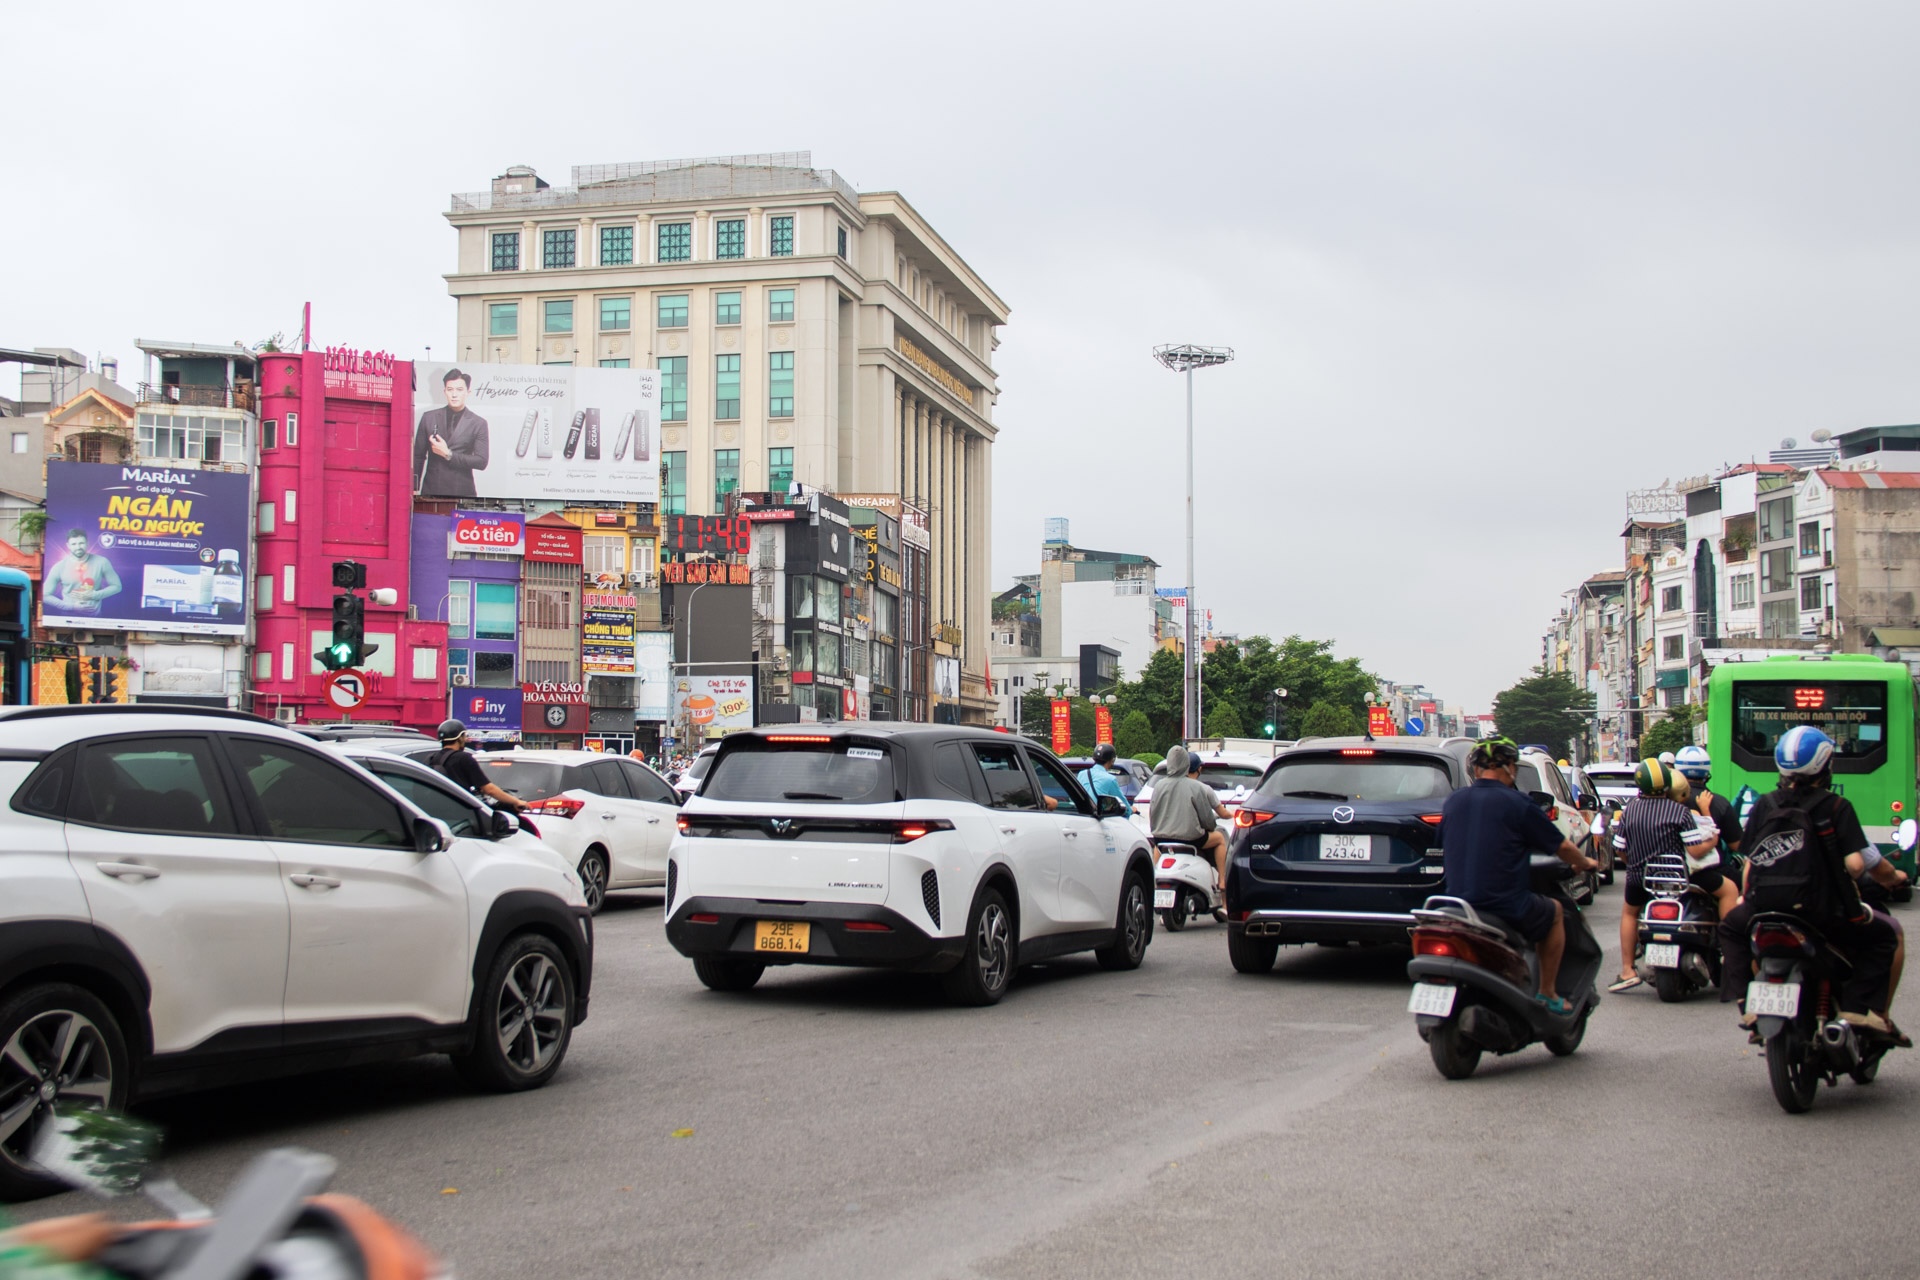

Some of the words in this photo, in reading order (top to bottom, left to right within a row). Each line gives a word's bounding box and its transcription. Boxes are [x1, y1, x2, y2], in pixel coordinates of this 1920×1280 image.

[325, 342, 358, 374] NÓN
[363, 350, 395, 378] SƠN
[107, 494, 192, 519] NGĂN
[99, 515, 142, 531] TRÀO
[145, 520, 204, 538] NGƯỢC
[460, 526, 480, 541] có
[482, 528, 515, 542] tiền
[678, 516, 751, 554] 11:48
[584, 621, 610, 634] CHỐNG
[611, 623, 632, 636] THẤM
[534, 679, 559, 692] YẾN
[523, 692, 545, 702] HOA
[548, 694, 571, 703] ANH
[475, 700, 506, 714] Finy
[1335, 835, 1355, 846] 30K
[1326, 848, 1364, 858] 243.40
[771, 923, 794, 935] 29E
[761, 937, 802, 950] 868.14
[1758, 985, 1791, 998] 15-B1
[1750, 998, 1794, 1013] 628.90
